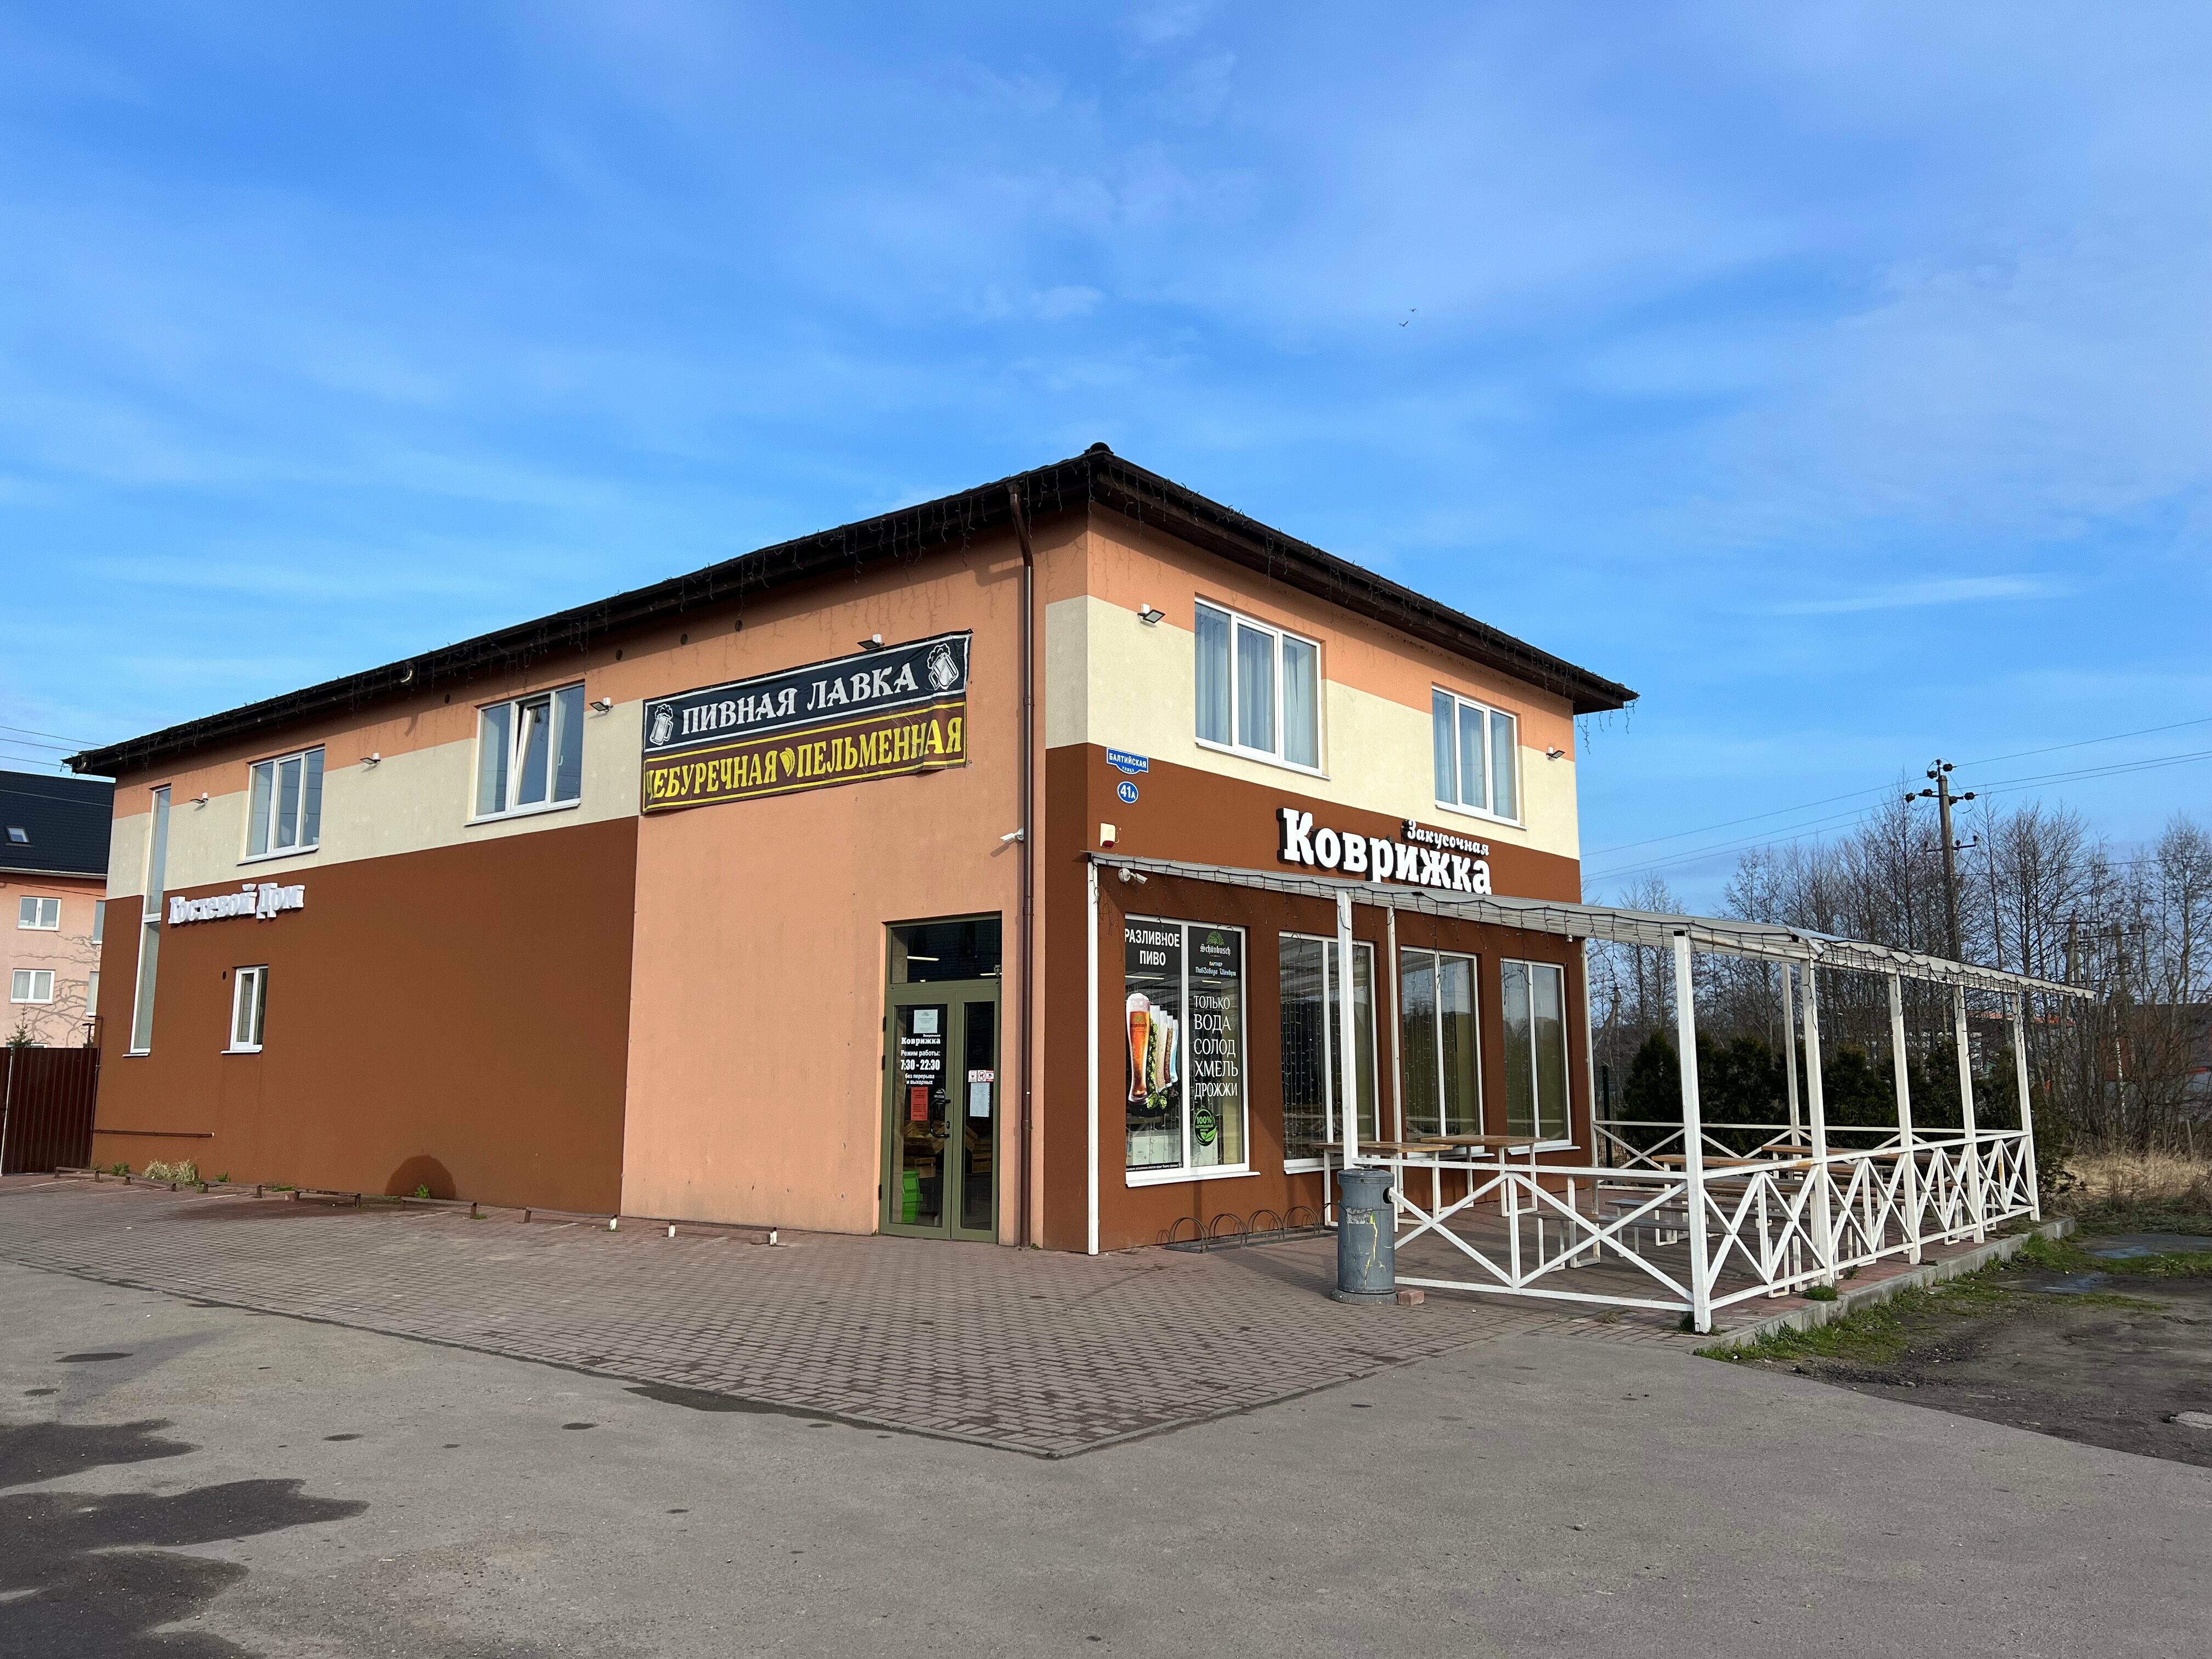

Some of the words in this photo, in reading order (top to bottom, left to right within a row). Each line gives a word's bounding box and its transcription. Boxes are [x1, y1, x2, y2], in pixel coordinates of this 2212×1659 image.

[681, 687, 798, 735] ПИВНАЯ
[806, 662, 918, 710] ЛАВКА
[646, 750, 778, 801] ЧЕБУРЕЧНАЯ
[797, 717, 963, 778] ПЕЛЬМЕННАЯ
[1109, 752, 1147, 768] БАЛТИЙСКАЯ
[1406, 819, 1489, 856] Закусочная
[1282, 808, 1492, 895] Коврижка
[168, 883, 257, 924] Гостевой
[256, 883, 305, 919] Дом
[1125, 928, 1180, 947] РАЗЛИВНОЕ
[1139, 950, 1166, 966] ПИВО
[1193, 996, 1230, 1010] ТОЛЬКО
[1194, 1014, 1232, 1034] ВОДА
[901, 1037, 941, 1046] Коврижка
[1194, 1039, 1236, 1058] СОЛОД
[900, 1059, 915, 1070] 7:30
[919, 1059, 940, 1070] 22:30
[1194, 1060, 1239, 1078] ХМЕЛЬ
[1194, 1082, 1238, 1101] ДРОЖЖИ
[1197, 1116, 1212, 1125] 100%
